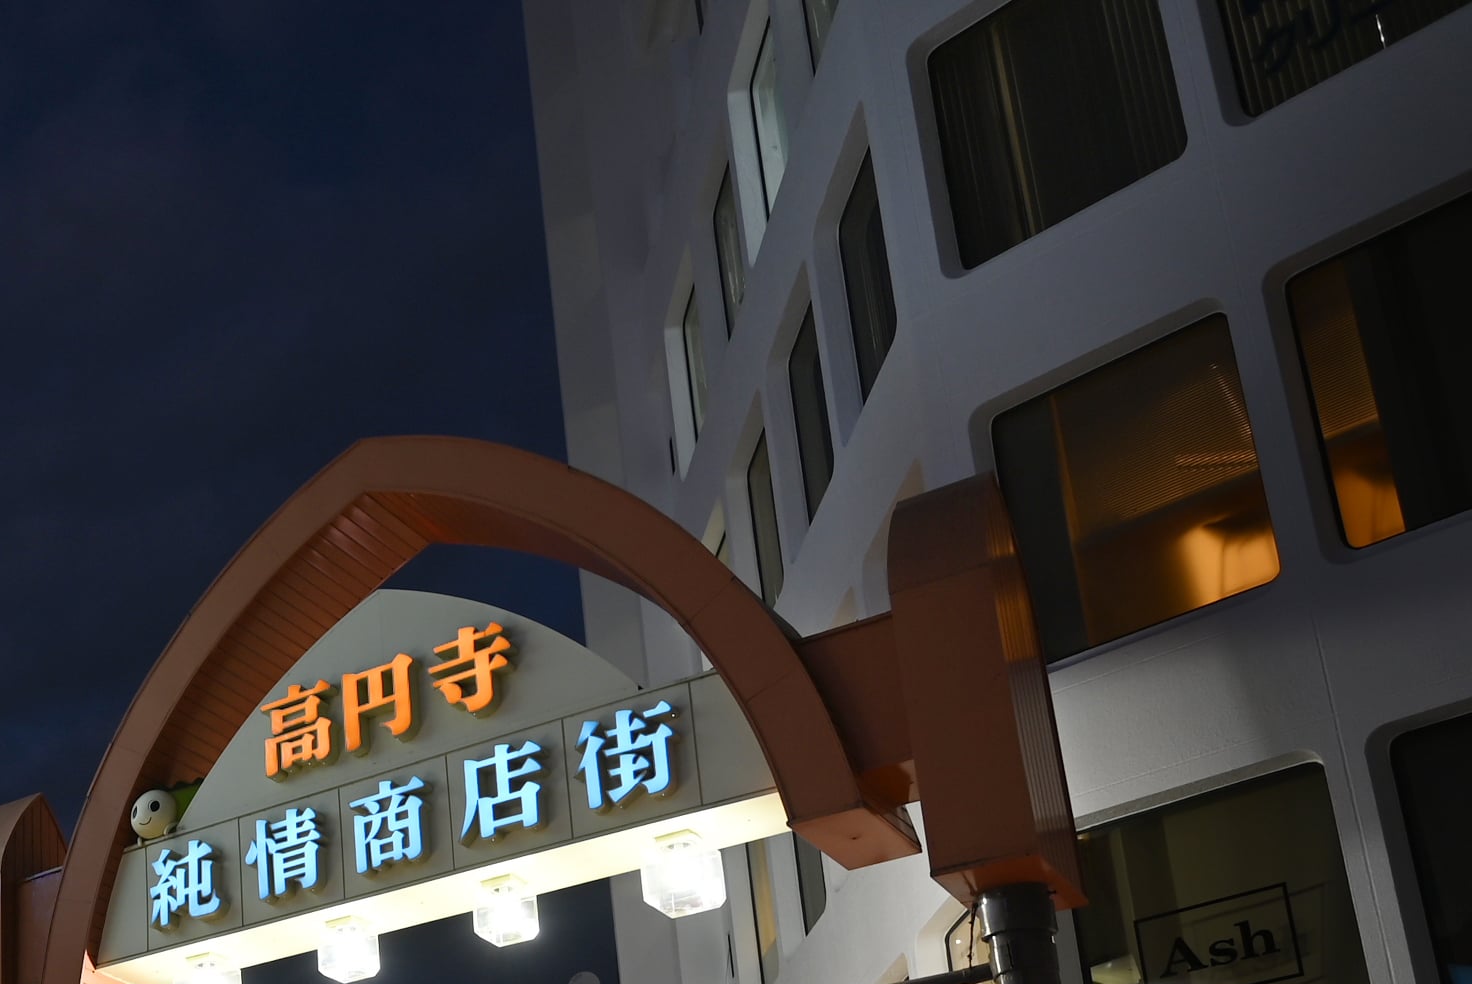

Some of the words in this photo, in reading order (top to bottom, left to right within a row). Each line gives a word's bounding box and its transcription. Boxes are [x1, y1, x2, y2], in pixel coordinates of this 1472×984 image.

[259, 621, 512, 779] 高円寺
[149, 700, 676, 930] 純情商店街
[1160, 920, 1280, 979] Ash
